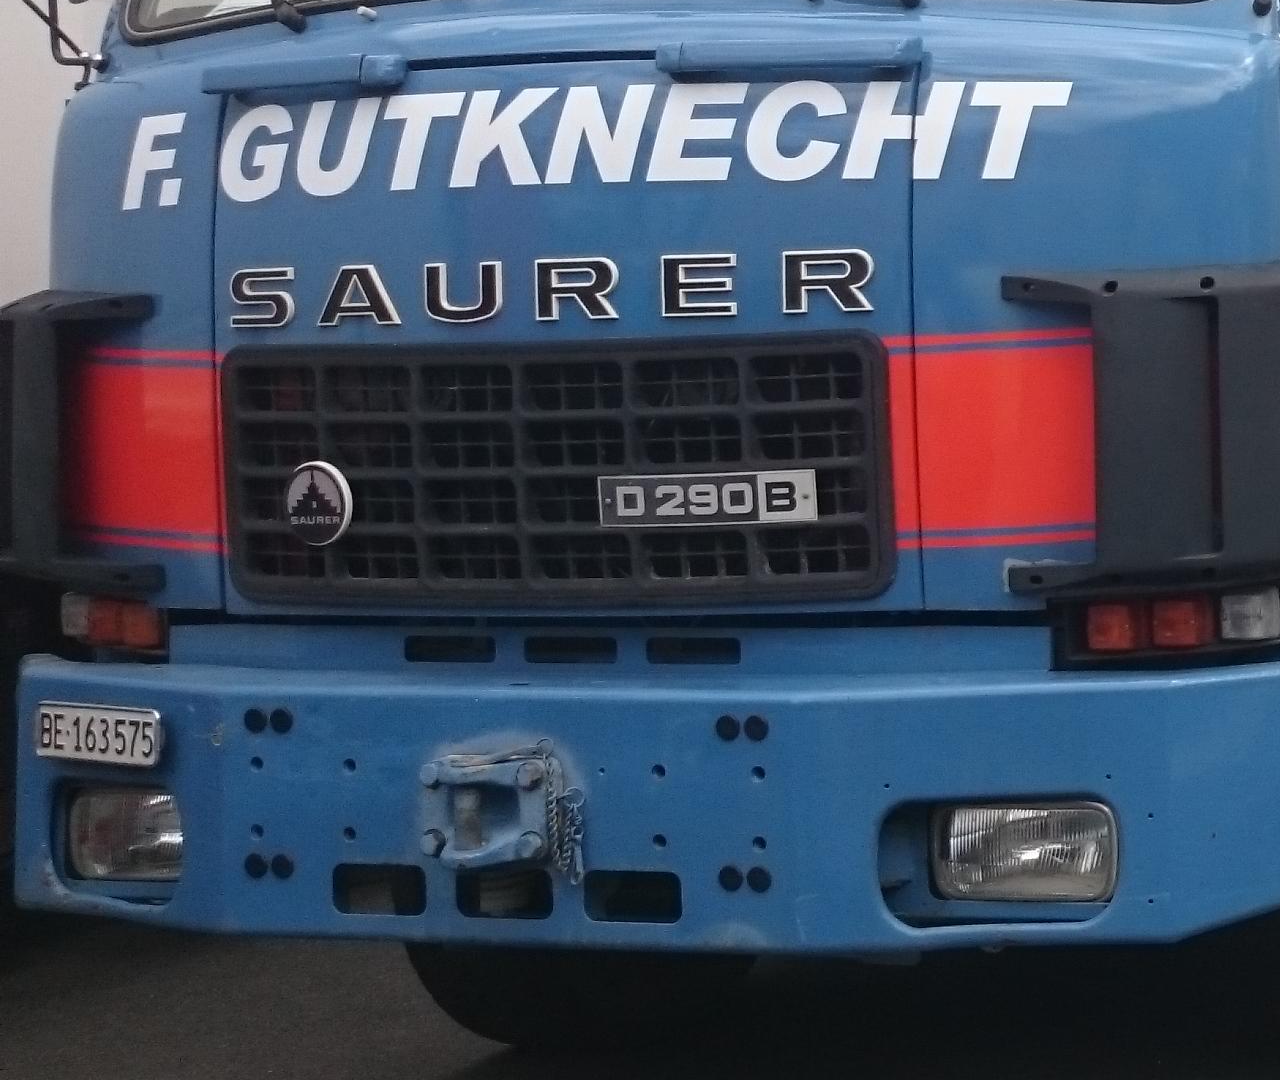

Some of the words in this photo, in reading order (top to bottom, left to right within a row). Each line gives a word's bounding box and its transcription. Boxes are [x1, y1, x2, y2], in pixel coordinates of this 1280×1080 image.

[121, 112, 187, 211] F.
[218, 80, 1074, 203] GUTKNECHT
[229, 249, 875, 328] SAURER
[290, 516, 341, 525] SAURER
